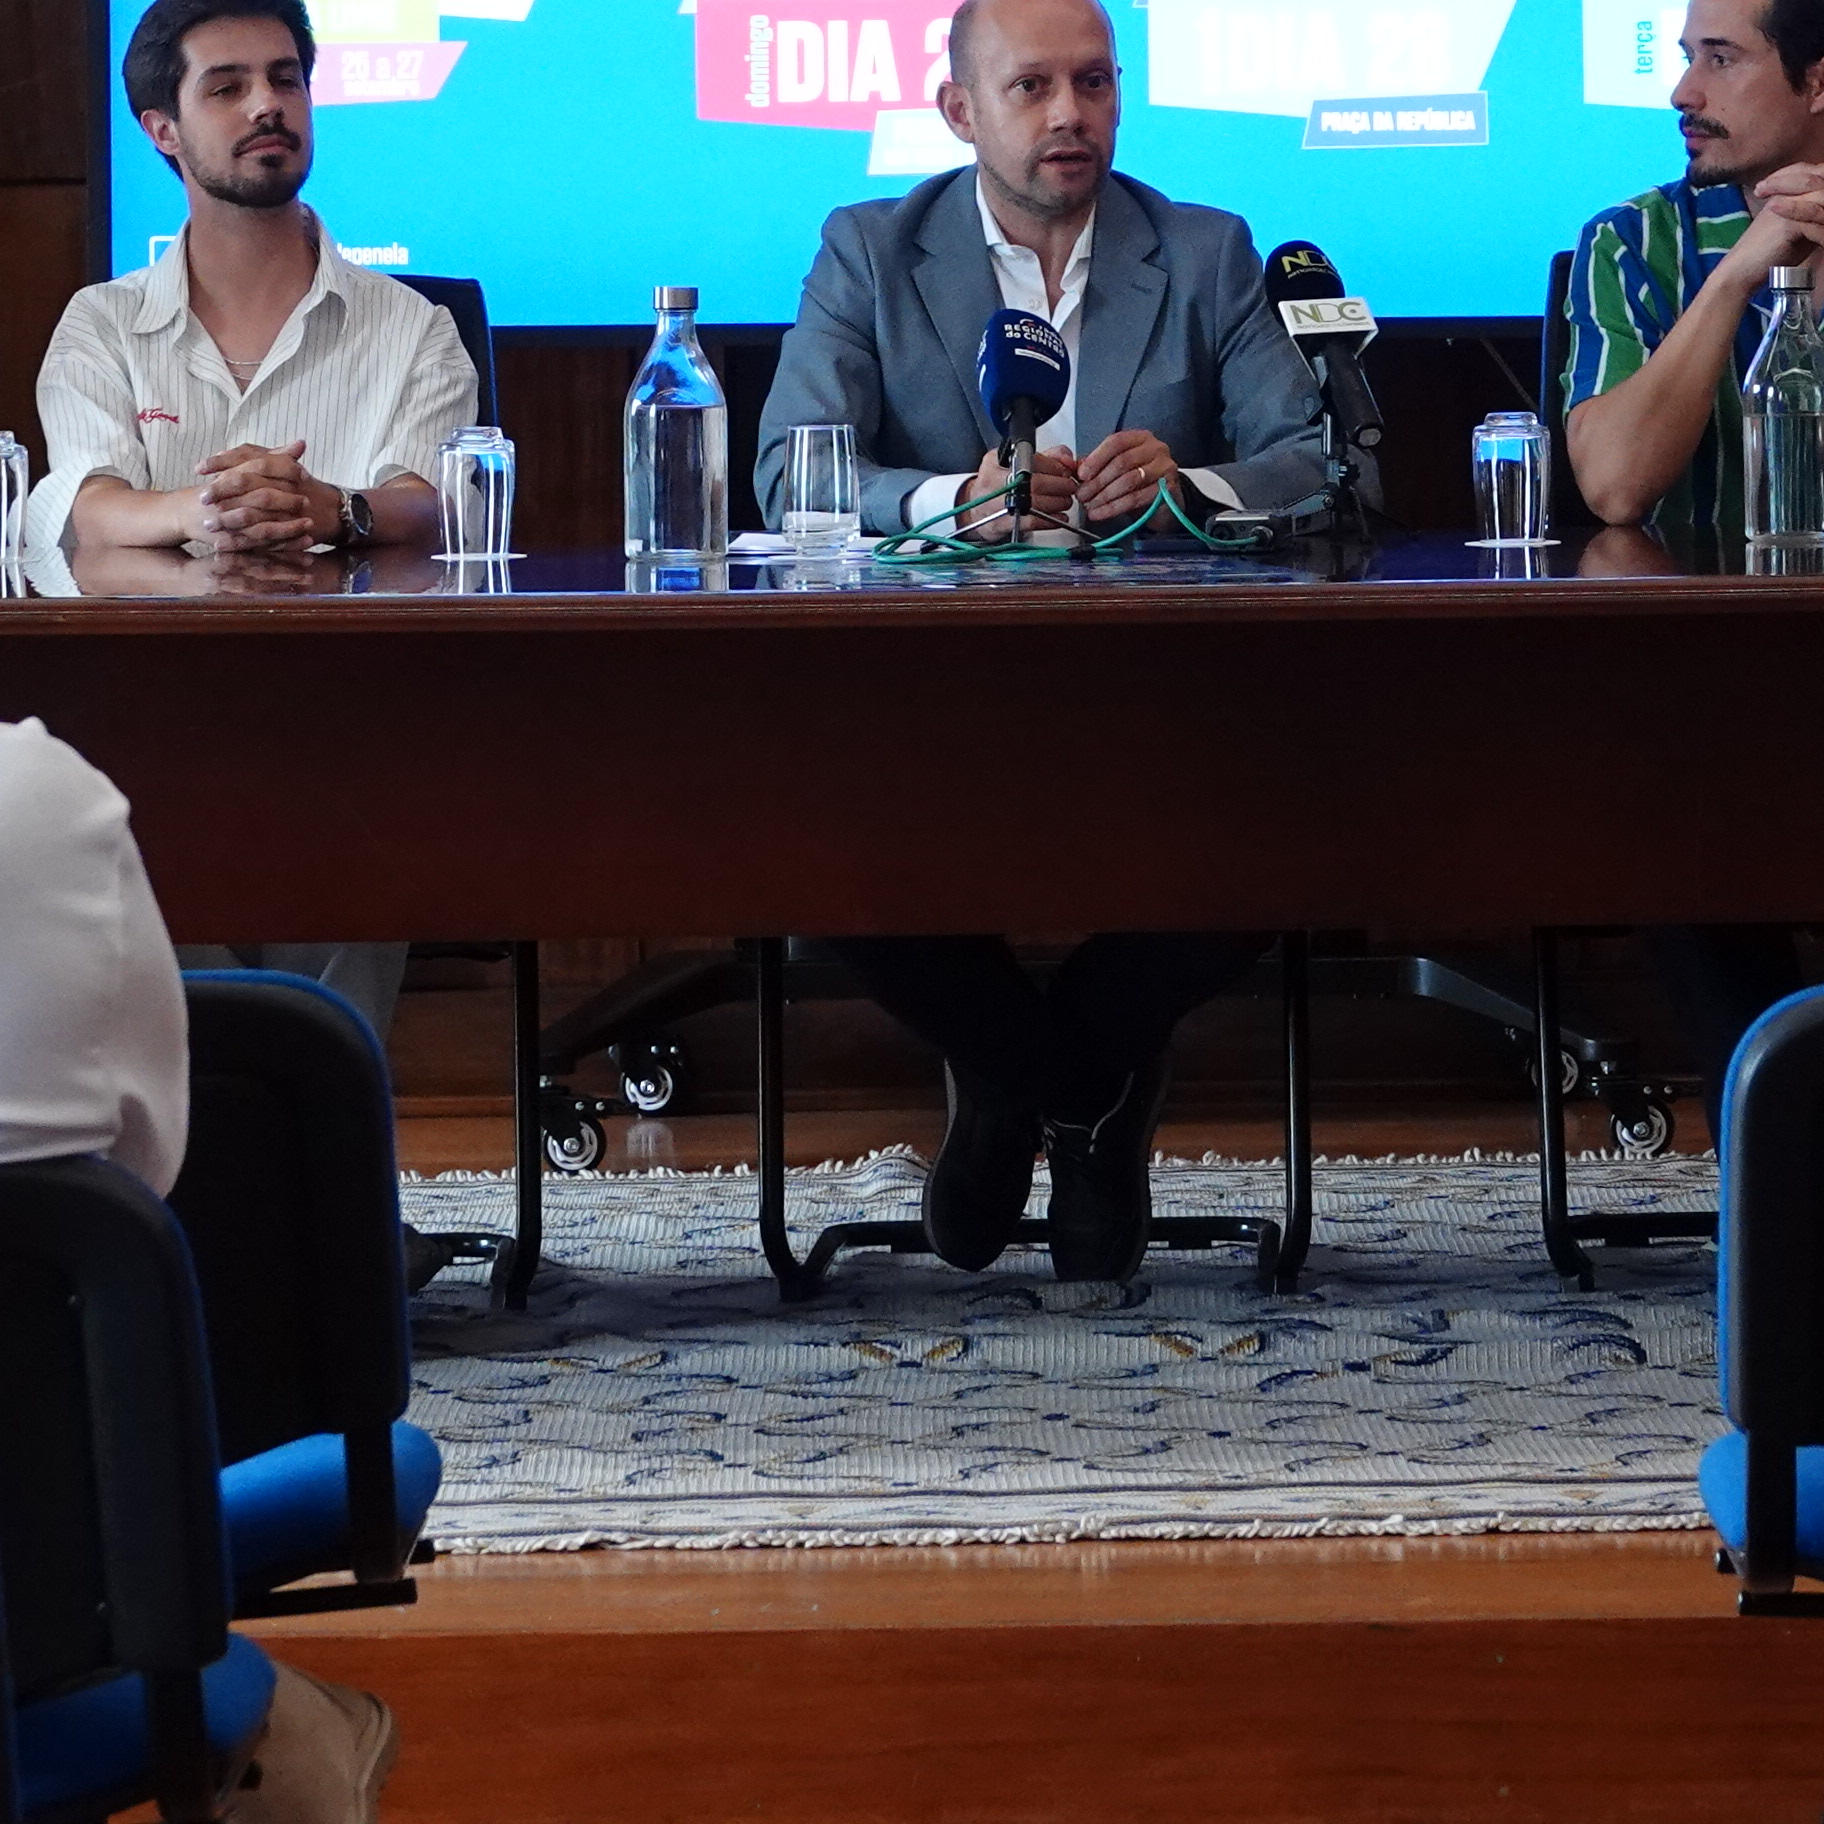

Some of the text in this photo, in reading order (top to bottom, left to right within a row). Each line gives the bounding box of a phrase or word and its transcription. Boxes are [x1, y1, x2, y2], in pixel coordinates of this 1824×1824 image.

[376, 57, 390, 80] a
[396, 50, 424, 80] 27
[744, 14, 774, 108] domingo
[777, 19, 902, 103] DIA
[1634, 20, 1656, 74] terça
[1281, 250, 1338, 273] ND
[1290, 302, 1367, 324] NDC
